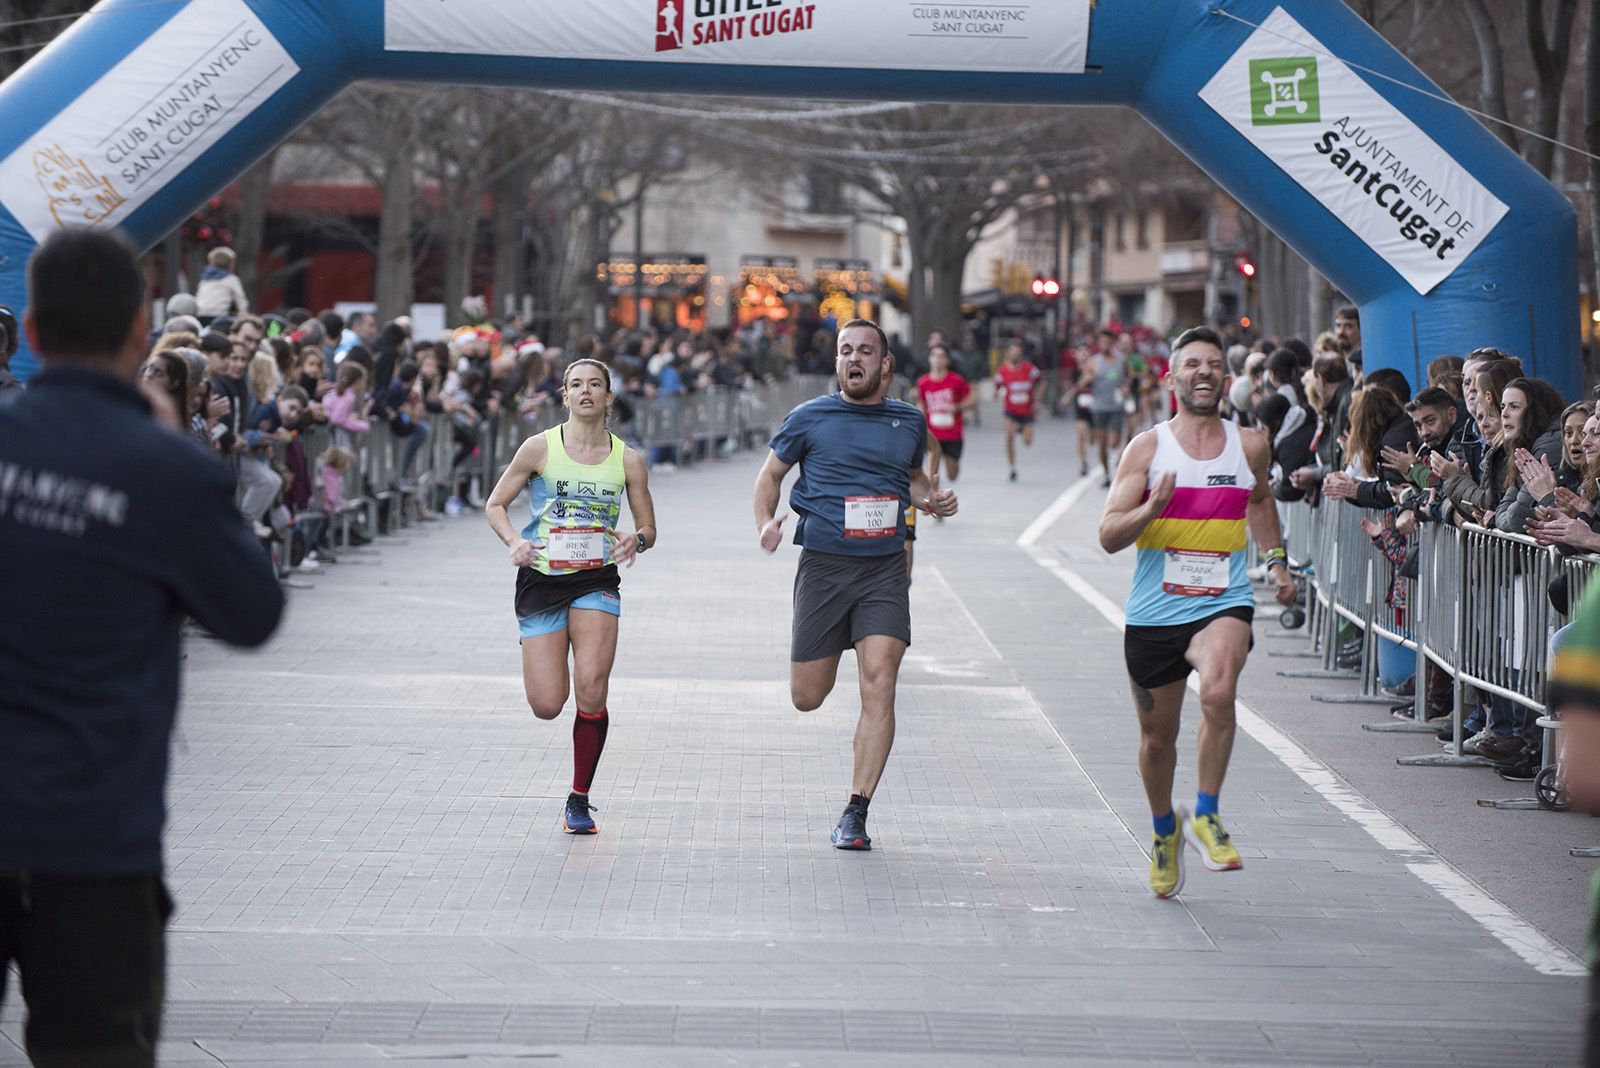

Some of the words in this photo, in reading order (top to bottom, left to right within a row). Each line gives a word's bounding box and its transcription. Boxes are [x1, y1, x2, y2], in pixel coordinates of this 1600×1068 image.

[692, 16, 745, 45] SANT
[750, 5, 817, 37] CUGAT
[912, 8, 940, 19] CLUB
[943, 9, 1026, 21] MUNTANYENC
[932, 22, 962, 32] SANT
[965, 22, 1004, 33] CUGAT
[105, 126, 149, 165] CLUB
[147, 29, 262, 132] MUNTANYENC
[121, 141, 167, 184] SANT
[166, 93, 223, 146] CUGAT
[1333, 115, 1449, 215] AJUNTAMENT
[1445, 210, 1474, 239] DE
[1314, 130, 1455, 260] SantCugat
[867, 519, 883, 528] 100
[570, 550, 588, 559] 266
[1180, 564, 1214, 576] FRANK
